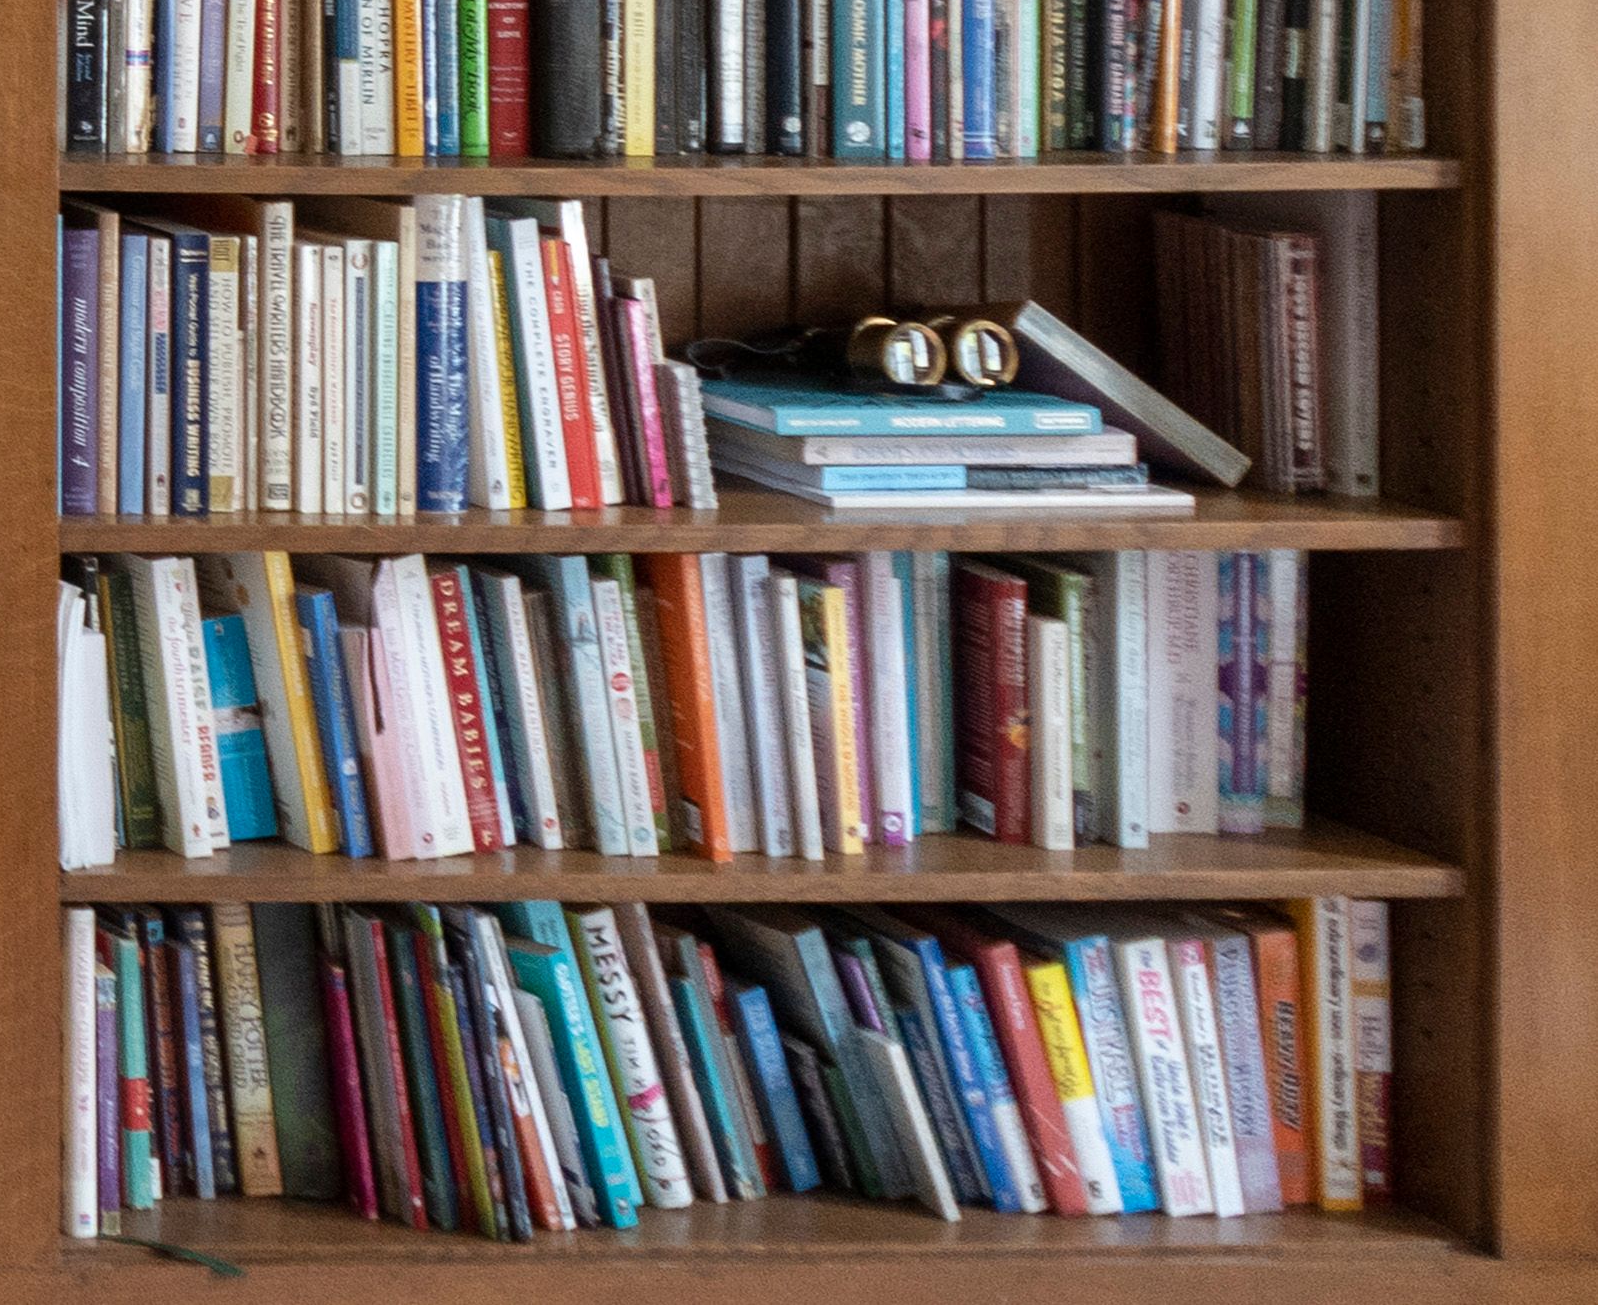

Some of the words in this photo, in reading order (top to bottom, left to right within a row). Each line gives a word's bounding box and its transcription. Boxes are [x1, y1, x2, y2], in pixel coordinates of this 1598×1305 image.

[78, 1, 96, 48] Mind
[852, 48, 866, 105] MOTHER
[75, 297, 92, 353] modern
[556, 333, 573, 371] STORY
[70, 360, 92, 446] composition
[186, 359, 200, 419] BUSINESS
[561, 375, 579, 420] GENIUS
[71, 456, 92, 468] 4
[186, 423, 199, 477] WRITING
[440, 579, 468, 676] DREAM
[458, 691, 487, 788] BABIES
[587, 925, 634, 1021] MESSY
